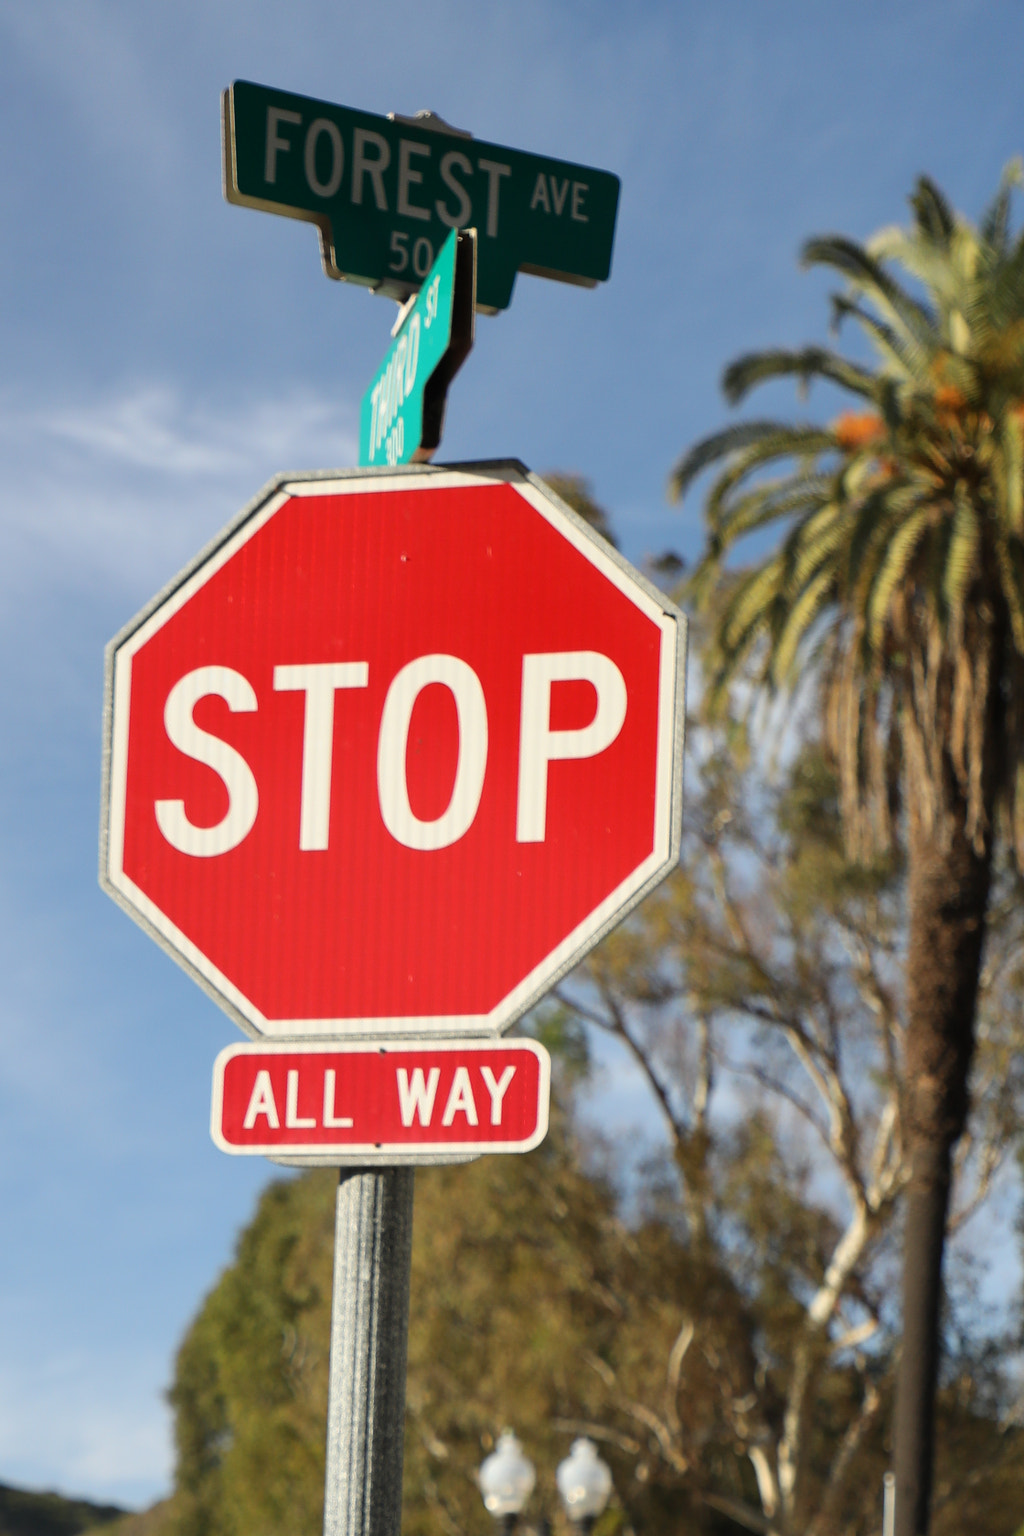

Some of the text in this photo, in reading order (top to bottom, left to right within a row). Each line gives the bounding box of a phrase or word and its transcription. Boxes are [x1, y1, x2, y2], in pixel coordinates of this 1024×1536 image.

[264, 105, 590, 237] FOREST AVE
[389, 229, 442, 278] 50
[369, 274, 441, 462] THIRD ST
[154, 650, 629, 858] STOP
[243, 1065, 517, 1130] ALL WAY
